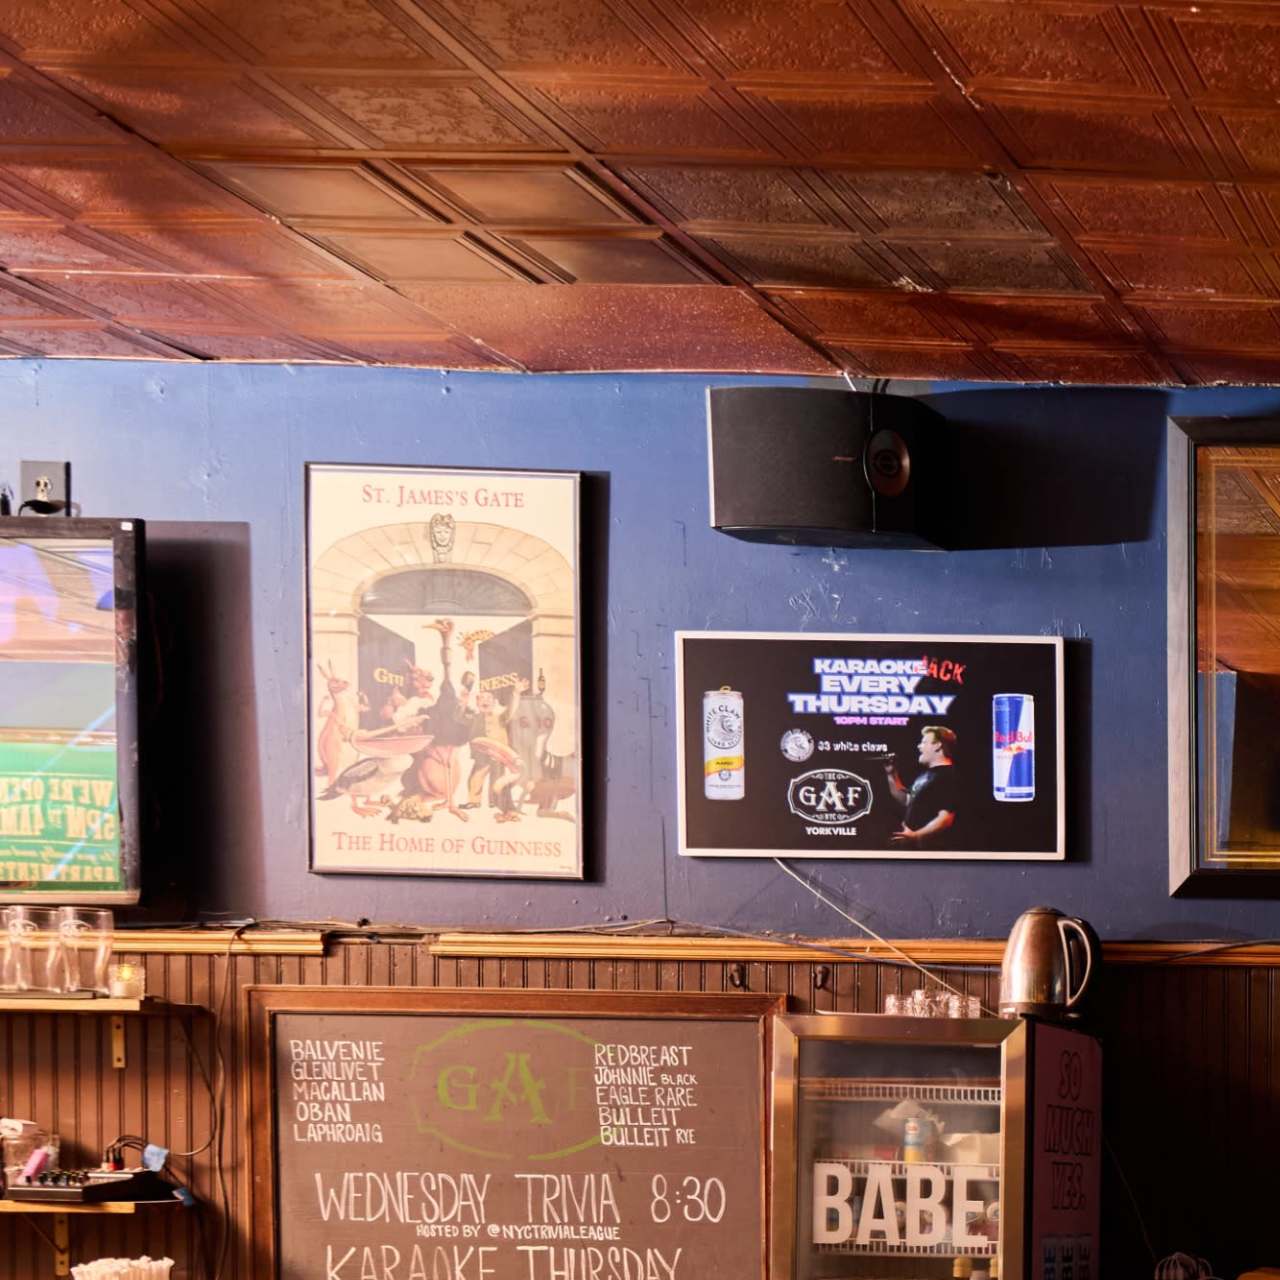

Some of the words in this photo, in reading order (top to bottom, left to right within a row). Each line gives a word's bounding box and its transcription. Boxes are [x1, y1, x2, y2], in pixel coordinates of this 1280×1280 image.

[396, 485, 468, 508] JAMES'S
[474, 488, 525, 508] GATE
[813, 658, 927, 675] KARAOKE
[821, 675, 921, 693] EVERY
[787, 693, 956, 714] THURSDAY
[869, 716, 909, 726] START
[799, 781, 862, 812] GAF
[805, 827, 857, 836] YORKVILLE
[331, 832, 372, 851] THE
[378, 833, 435, 853] HOME
[441, 838, 466, 854] OF
[471, 836, 562, 858] GUINNESS
[289, 1039, 385, 1061] BALVENIE
[594, 1043, 693, 1067] REDBREAST
[291, 1060, 382, 1081] GLENLIVET
[594, 1066, 657, 1086] JOHNNIE
[661, 1074, 698, 1086] BLACK
[292, 1081, 385, 1102] MACALLAN
[596, 1086, 651, 1105] EAGLE
[654, 1087, 698, 1107] RARE
[296, 1101, 351, 1122] OBAN
[598, 1106, 680, 1126] BULLEIT
[293, 1123, 384, 1143] LAPHROAIG
[600, 1126, 671, 1147] BULLEIT
[675, 1128, 697, 1144] RYE
[315, 1172, 491, 1224] WEDNESDAY
[514, 1173, 621, 1224] TRIVIA
[651, 1174, 727, 1224] 8:30
[813, 1163, 989, 1247] BABE
[416, 1225, 460, 1237] HOSTED
[462, 1225, 481, 1238] BY
